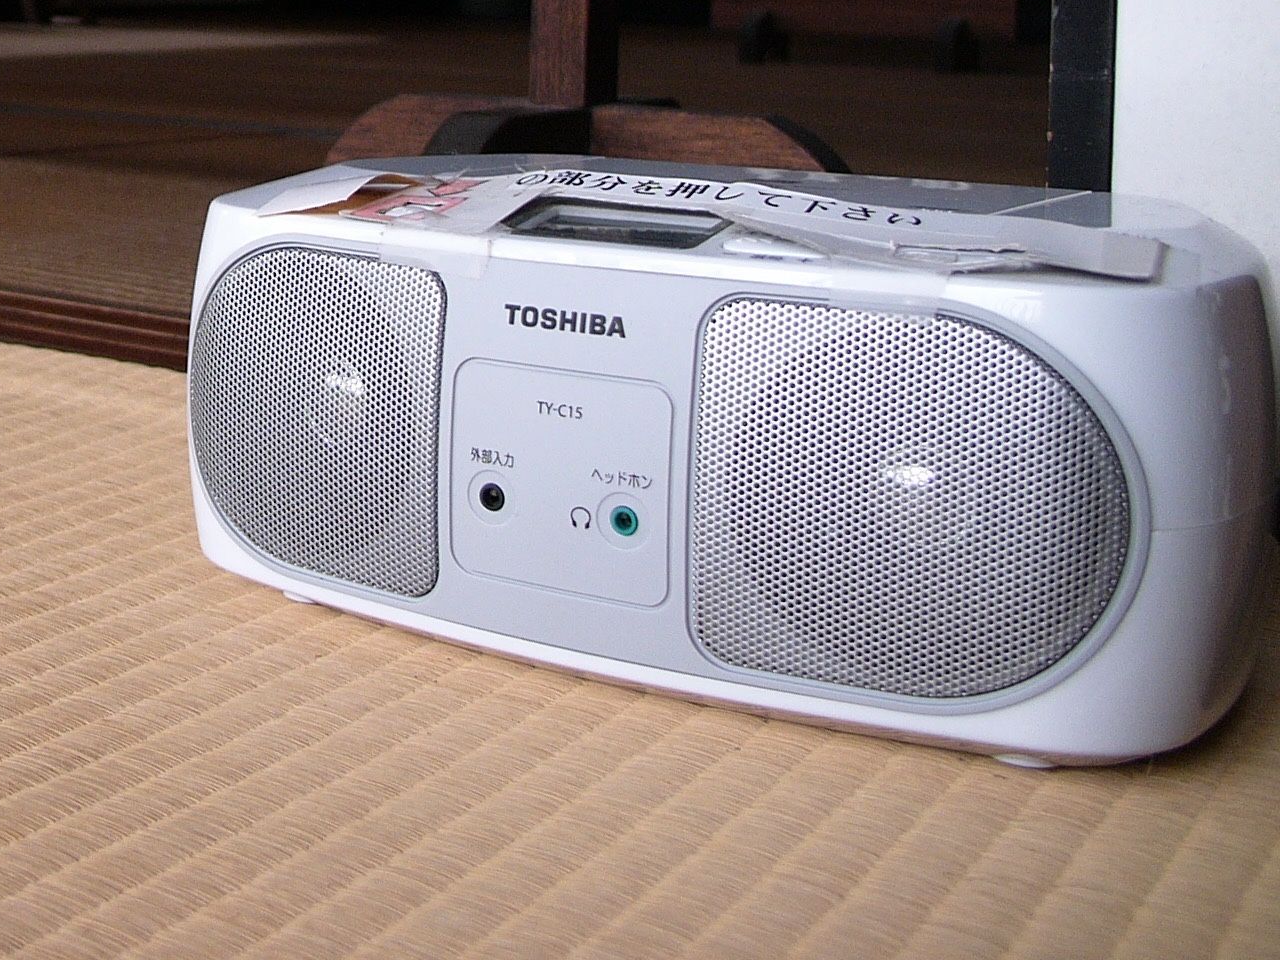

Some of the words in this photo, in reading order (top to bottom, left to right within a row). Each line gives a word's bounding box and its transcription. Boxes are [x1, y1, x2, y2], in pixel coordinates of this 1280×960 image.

[516, 169, 922, 226] の部分を押して下さい
[504, 303, 626, 339] TOSHIBA
[536, 400, 584, 420] TY-C15
[470, 446, 515, 469] 外部入力
[591, 468, 653, 490] ヘッドホン
